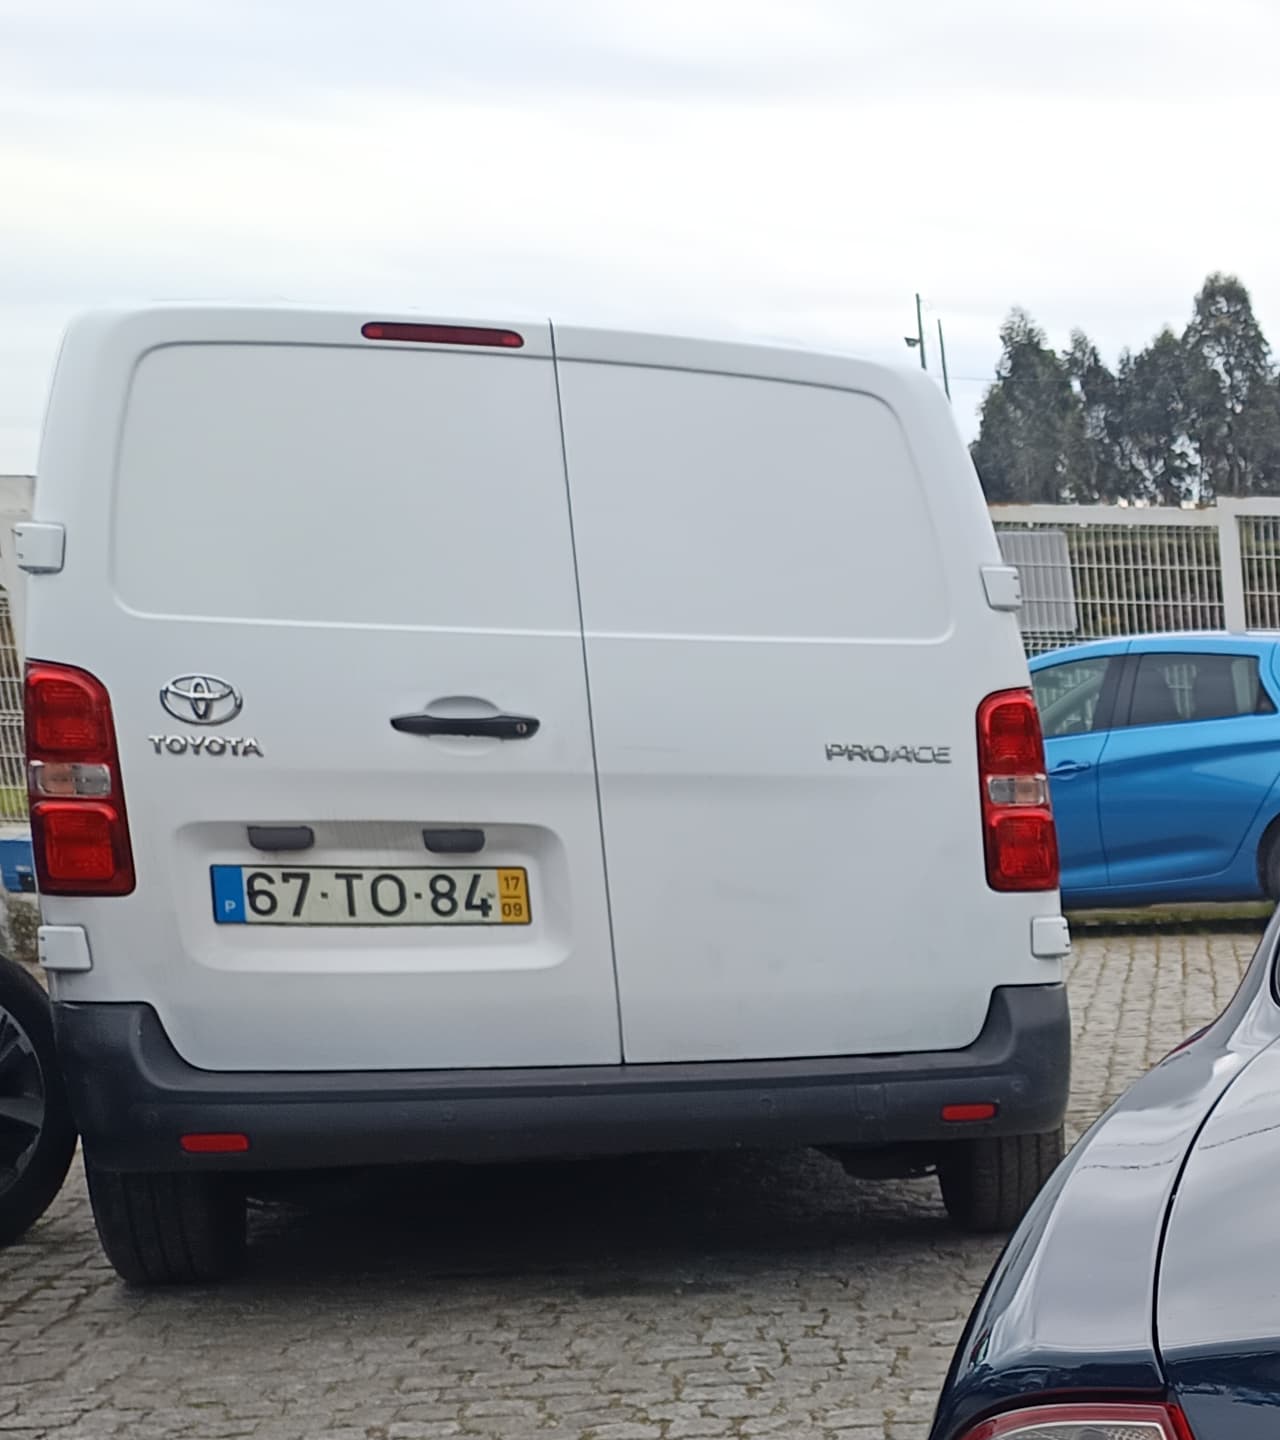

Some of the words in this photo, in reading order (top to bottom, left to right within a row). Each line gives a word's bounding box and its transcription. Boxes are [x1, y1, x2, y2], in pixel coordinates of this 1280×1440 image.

[148, 734, 265, 758] TOYOTA
[824, 743, 953, 764] PROACE
[503, 876, 520, 891] 17
[224, 900, 236, 913] P
[501, 902, 523, 917] 09
